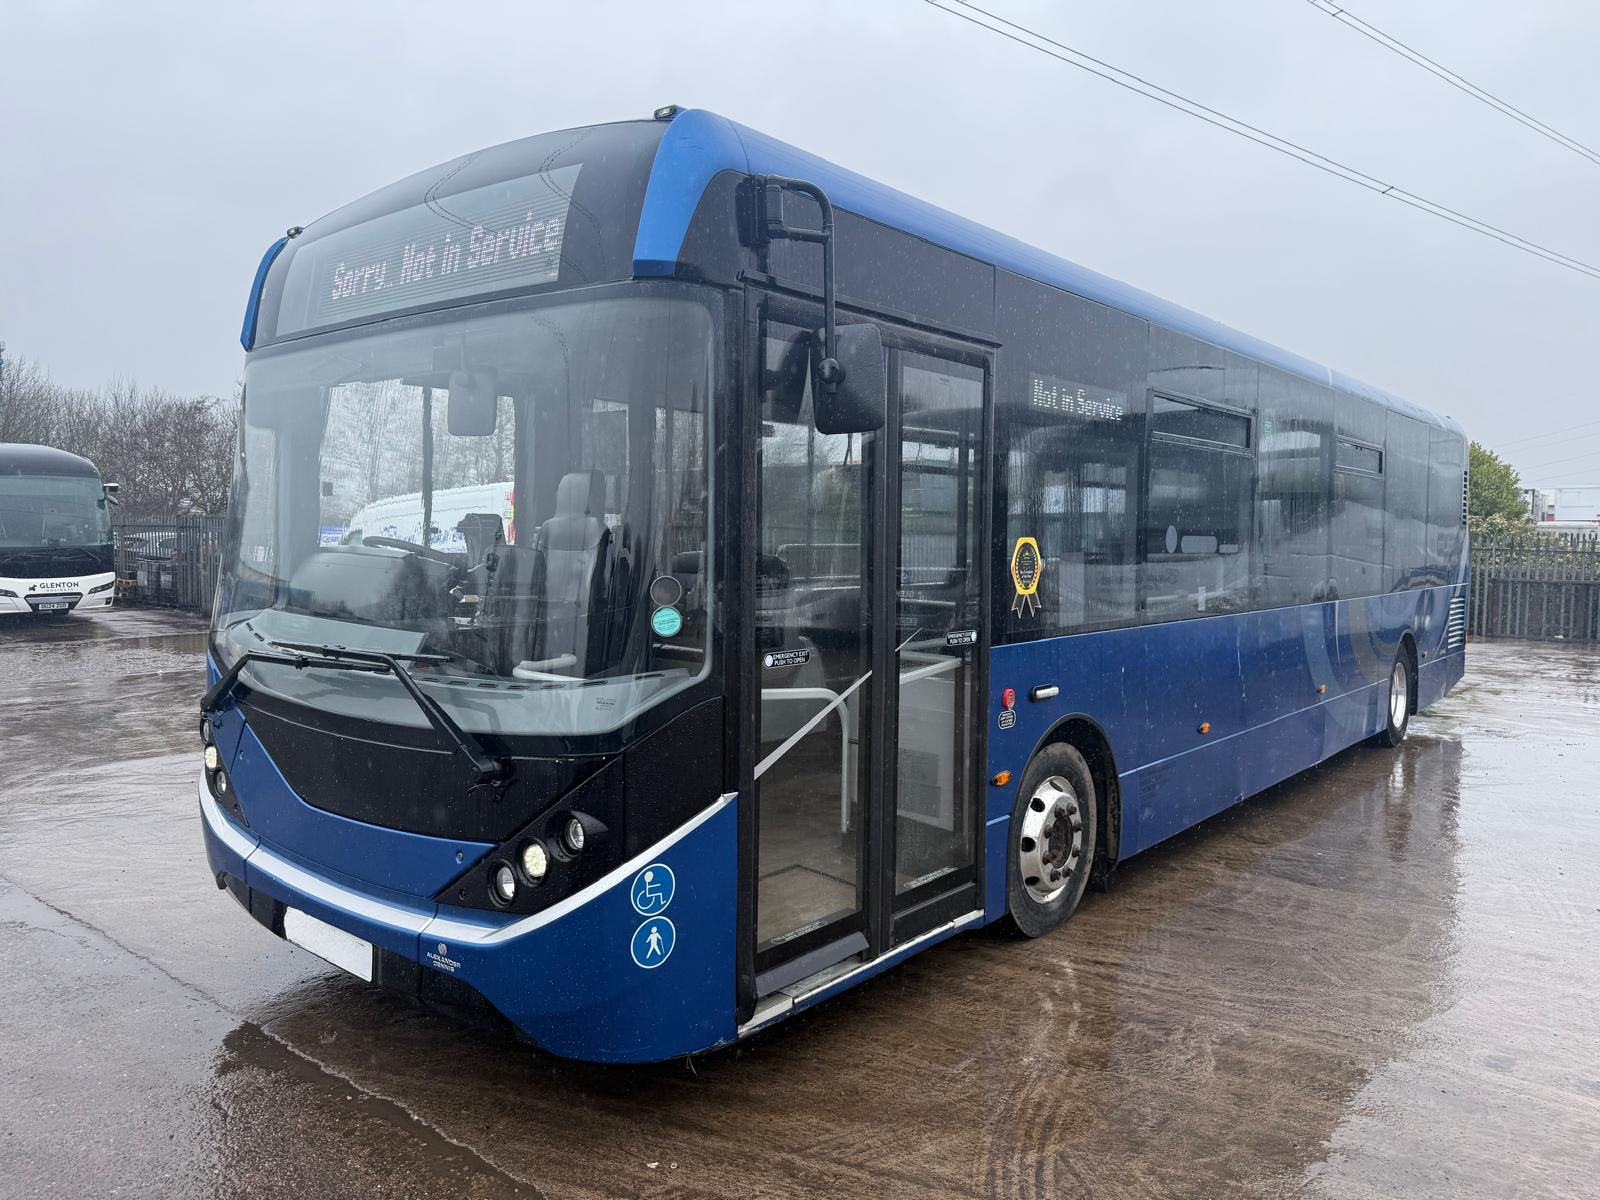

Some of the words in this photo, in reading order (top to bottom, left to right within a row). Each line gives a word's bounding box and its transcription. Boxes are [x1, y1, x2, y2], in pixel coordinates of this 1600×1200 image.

[400, 243, 436, 284] Not
[441, 231, 461, 275] in
[466, 209, 560, 269] Service
[1033, 379, 1058, 409] Not
[1061, 388, 1074, 412] in
[1076, 389, 1123, 421] Service
[426, 952, 461, 968] ALEXANDER
[432, 960, 454, 972] DENNIS
